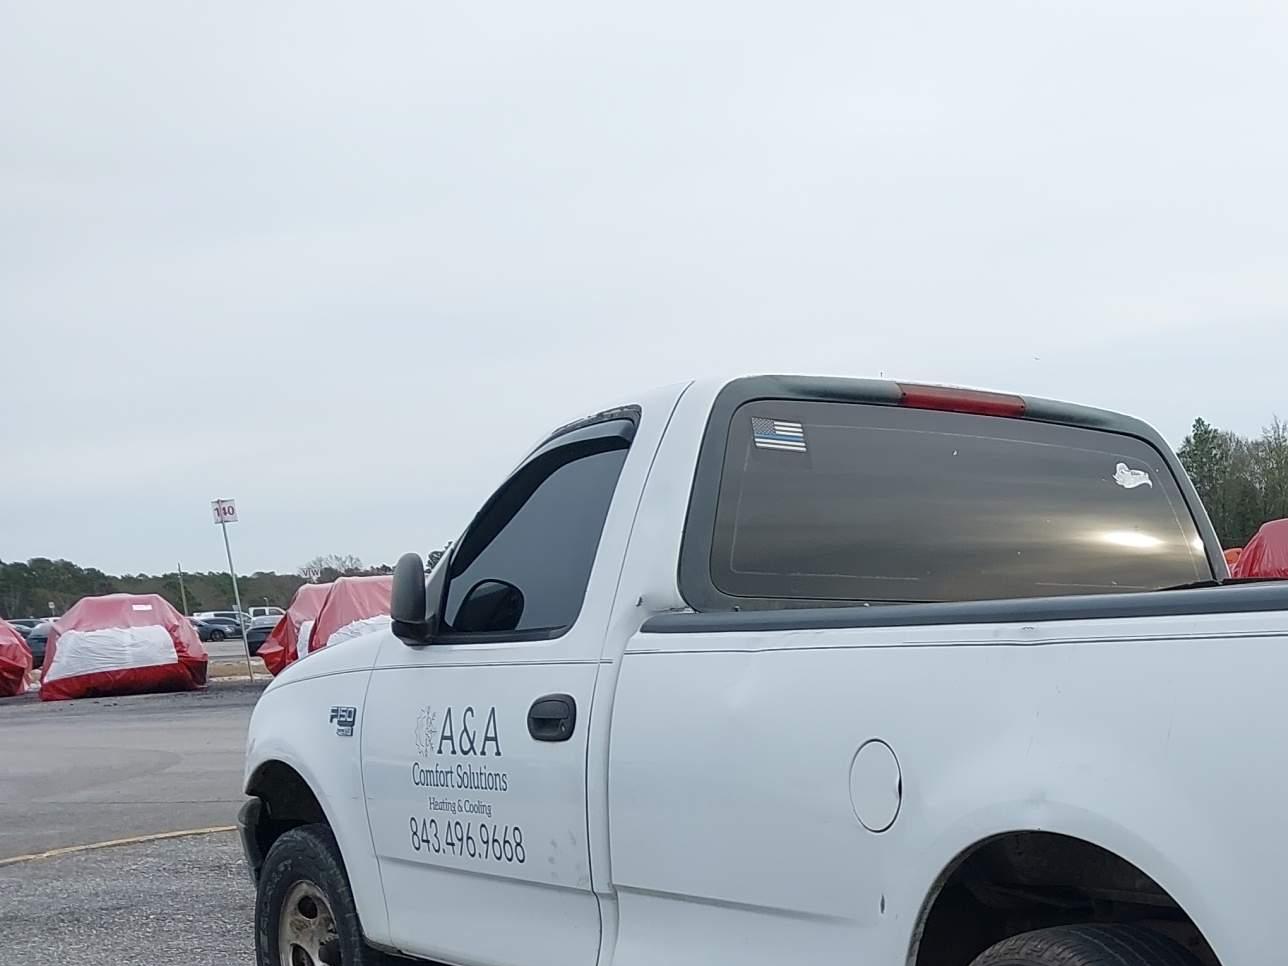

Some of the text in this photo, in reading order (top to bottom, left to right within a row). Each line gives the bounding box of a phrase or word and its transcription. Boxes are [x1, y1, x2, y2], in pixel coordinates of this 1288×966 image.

[213, 505, 235, 517] 140
[437, 706, 502, 756] A&A
[412, 762, 508, 792] Comfort Solutions
[429, 797, 492, 818] Heating & Cooling
[409, 817, 526, 864] 843.496.9668
